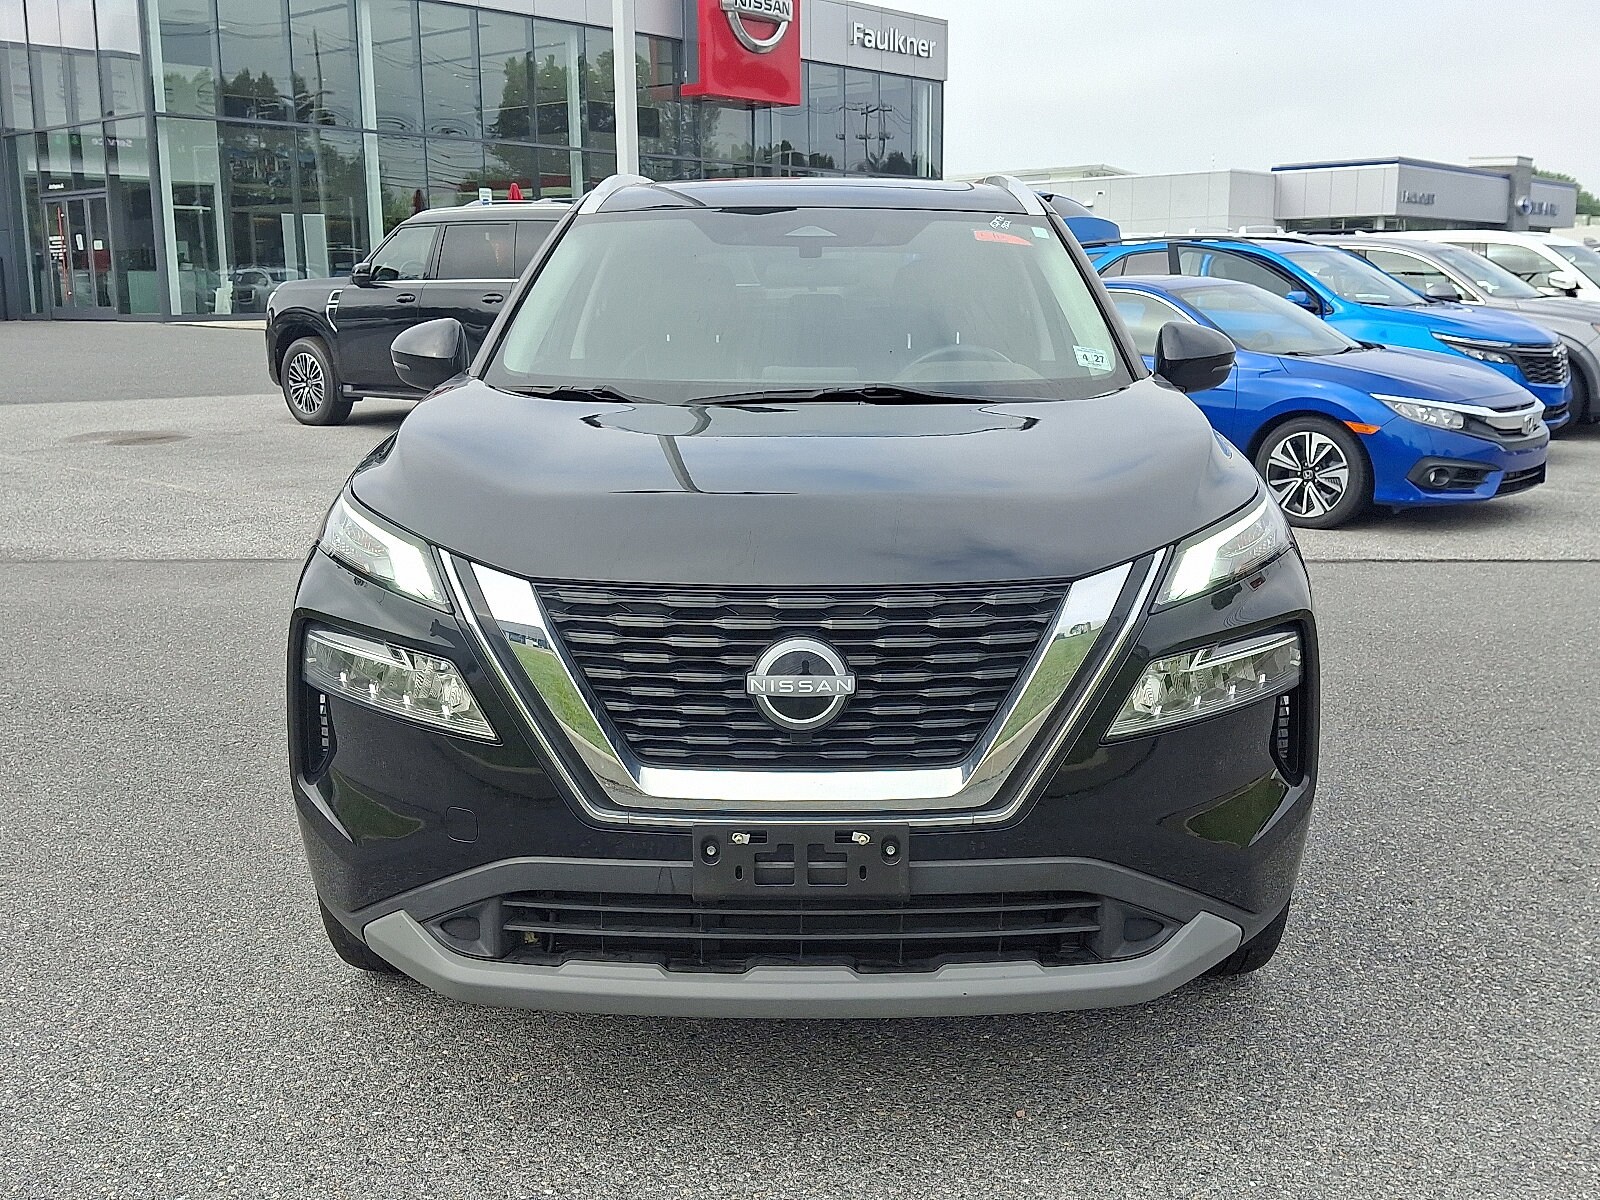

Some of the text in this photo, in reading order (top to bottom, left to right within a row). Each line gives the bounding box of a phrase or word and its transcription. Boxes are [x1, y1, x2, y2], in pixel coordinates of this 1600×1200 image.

[851, 21, 936, 58] Faulkner
[1093, 354, 1104, 363] 27
[750, 679, 852, 693] NISSAN
